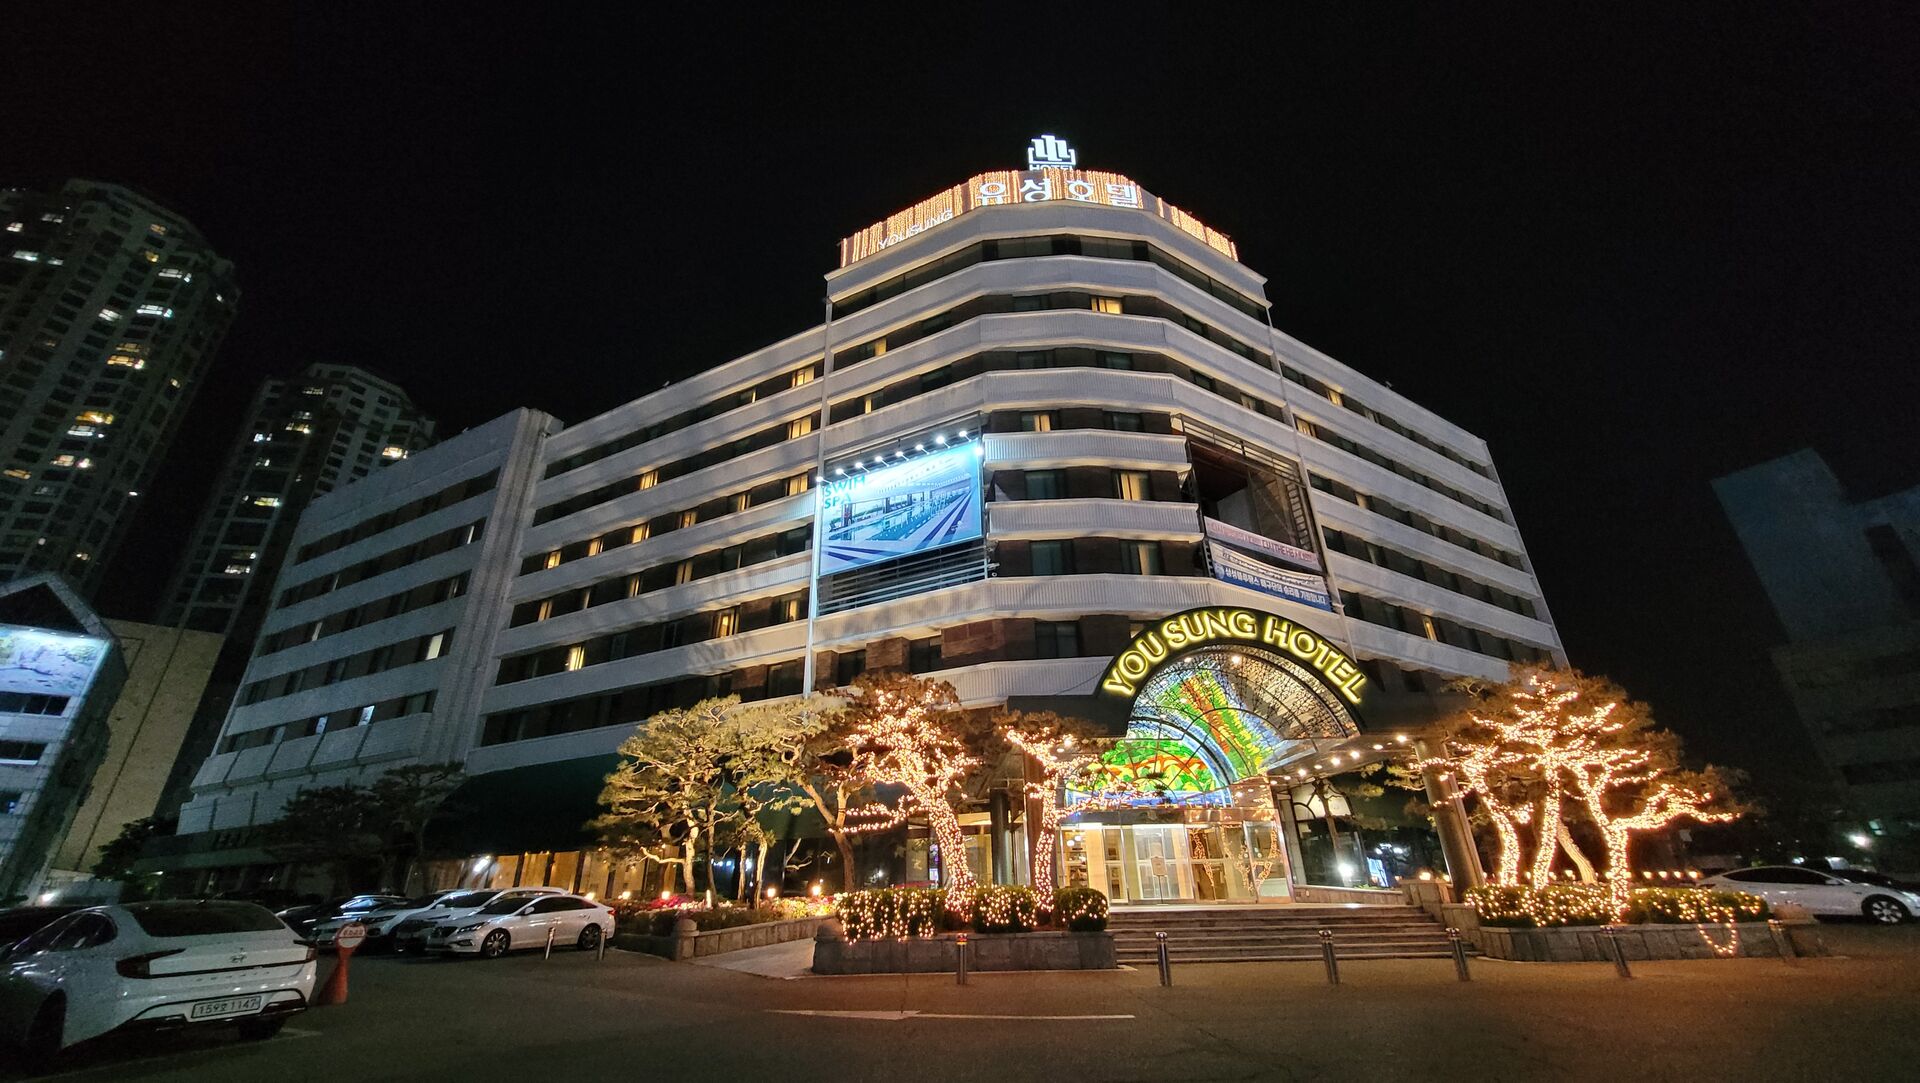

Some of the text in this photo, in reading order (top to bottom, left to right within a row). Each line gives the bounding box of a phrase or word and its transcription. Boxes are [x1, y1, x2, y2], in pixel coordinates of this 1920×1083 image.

[976, 178, 1138, 208] 유성호텔
[824, 474, 866, 497] SWIM
[824, 493, 851, 509] SPA
[1103, 610, 1367, 703] YOU SUNG HOTEL
